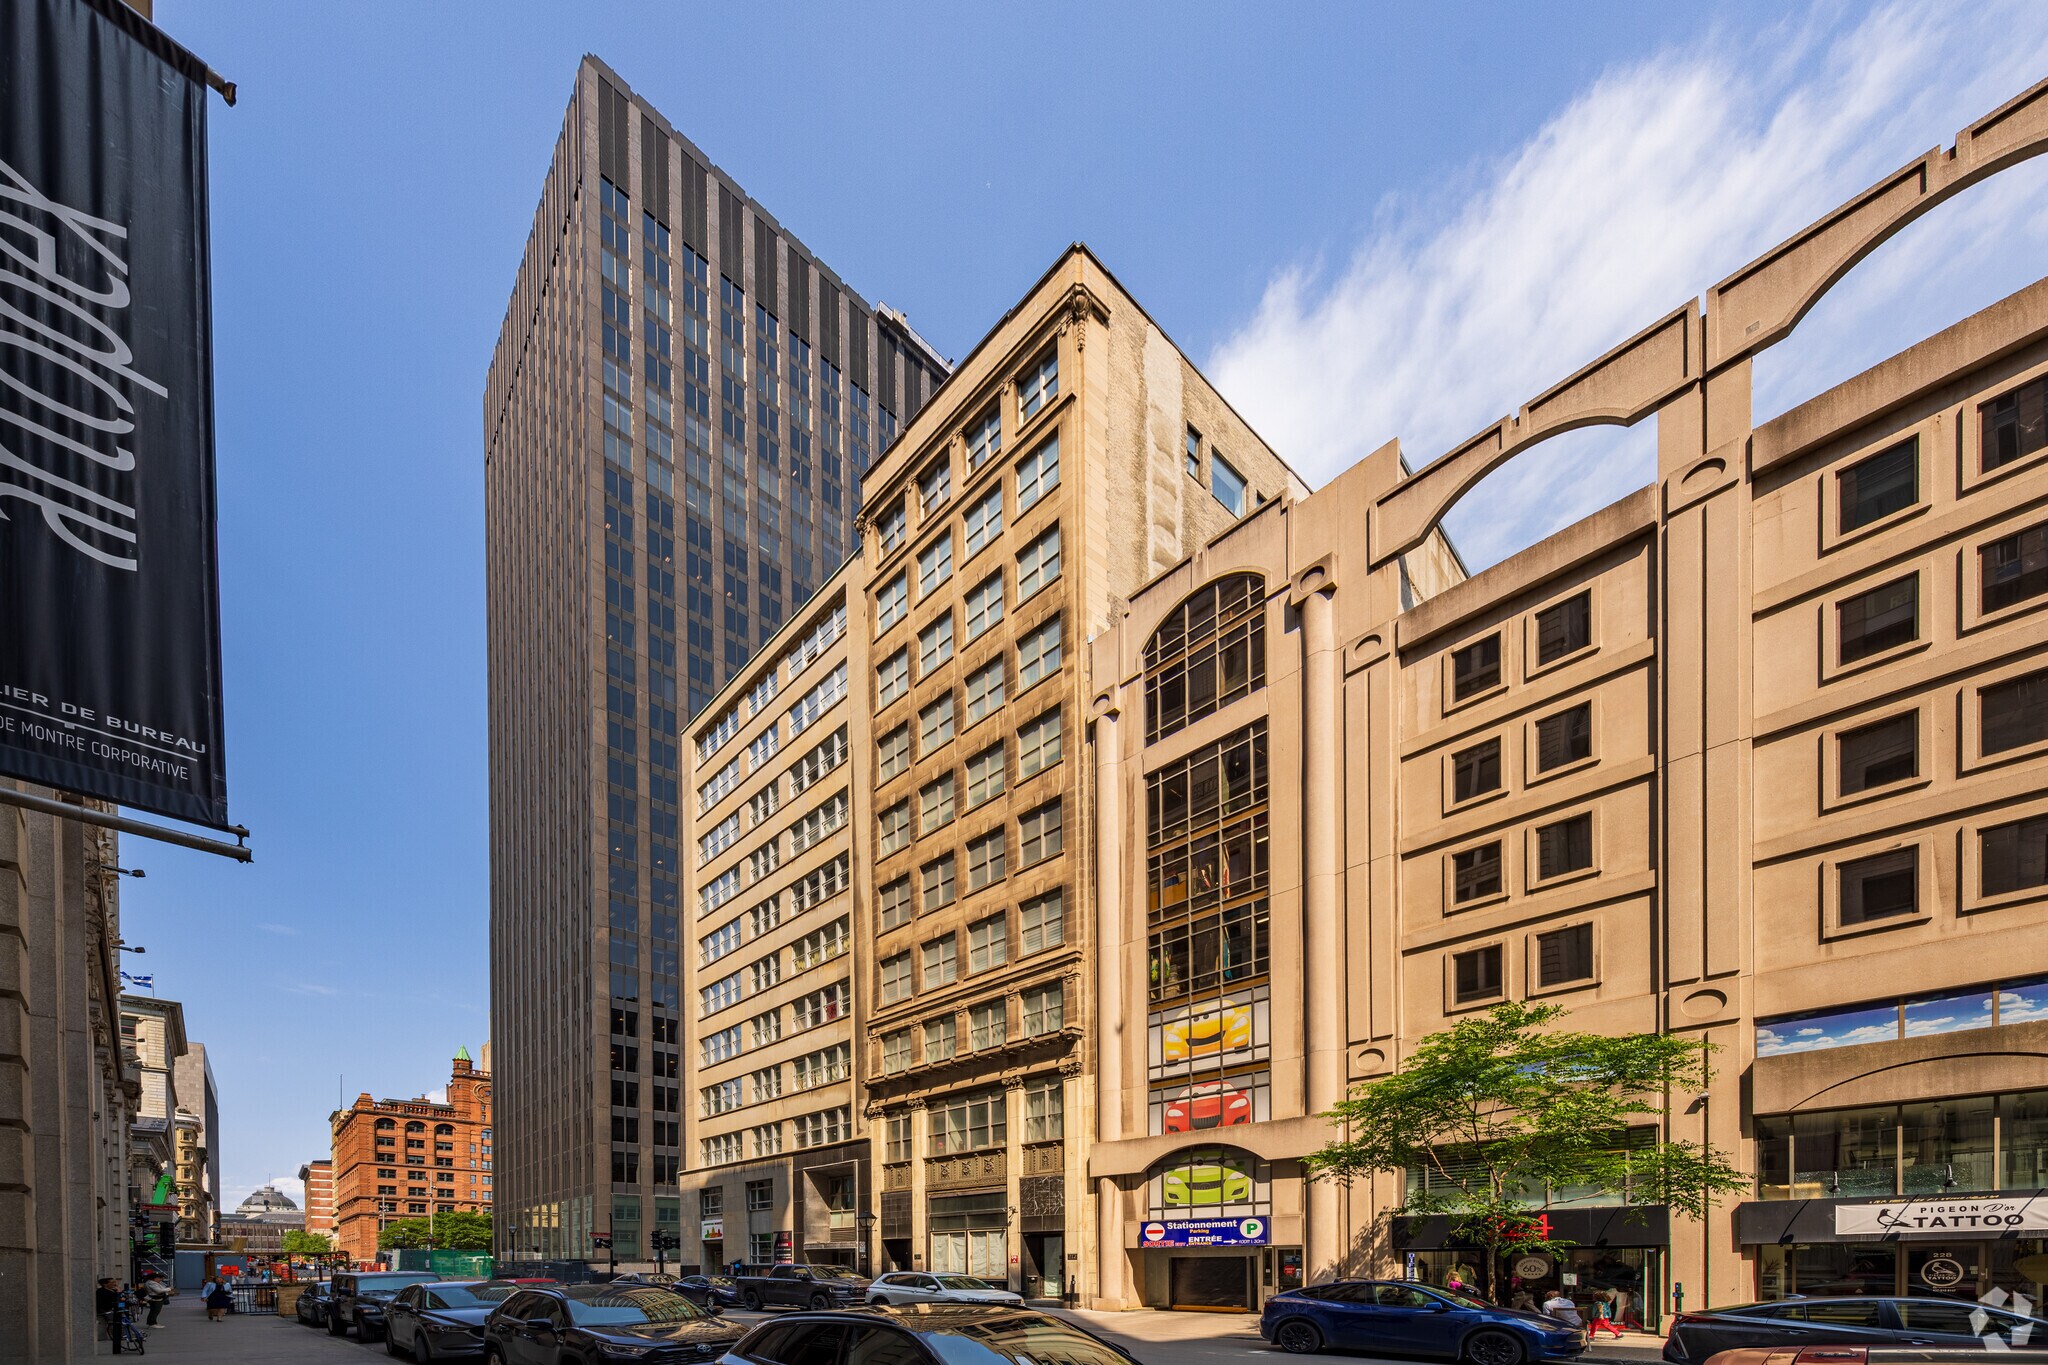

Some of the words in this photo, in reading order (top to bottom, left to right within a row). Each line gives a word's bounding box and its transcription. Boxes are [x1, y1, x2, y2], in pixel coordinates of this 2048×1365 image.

[61, 702, 95, 720] DE
[106, 715, 206, 753] BUREAU
[21, 721, 86, 751] MONTRE
[91, 741, 188, 780] CORPORATIVE
[1920, 1205, 1980, 1214] PIGEON
[1983, 1203, 2016, 1213] D'or
[1167, 1219, 1237, 1230] Stationnement
[1913, 1214, 2024, 1228] TATTOO
[1246, 1223, 1258, 1235] P
[1143, 1239, 1174, 1247] SORTIE
[1188, 1235, 1222, 1243] ENTRÉE
[1522, 1264, 1544, 1273] 60%
